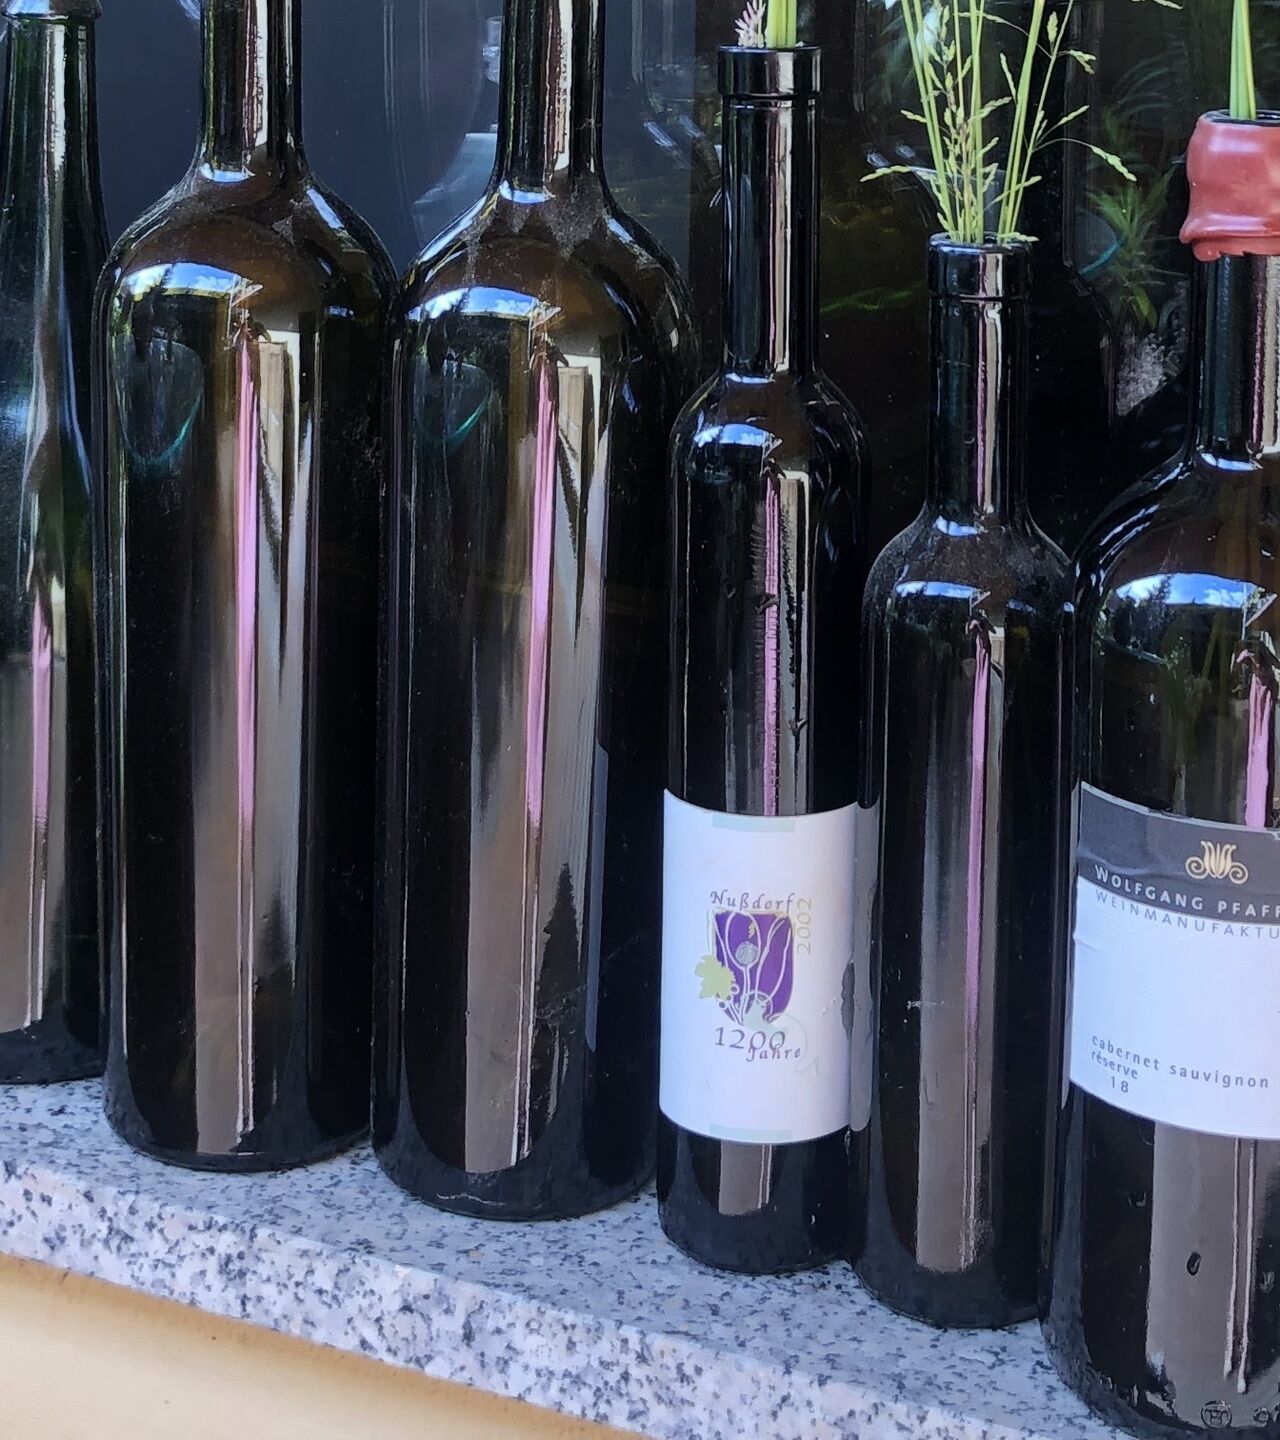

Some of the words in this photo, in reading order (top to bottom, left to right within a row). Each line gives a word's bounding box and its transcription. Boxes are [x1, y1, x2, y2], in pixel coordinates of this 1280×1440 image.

[1093, 864, 1204, 910] WOLFGANG
[709, 889, 796, 913] Nußdorf
[796, 897, 812, 954] 2002
[714, 1026, 786, 1051] 1200
[745, 1046, 801, 1062] Jahre
[1091, 1035, 1160, 1071] cabernet
[1169, 1064, 1270, 1089] sauvignon
[1109, 1075, 1129, 1094] 18
